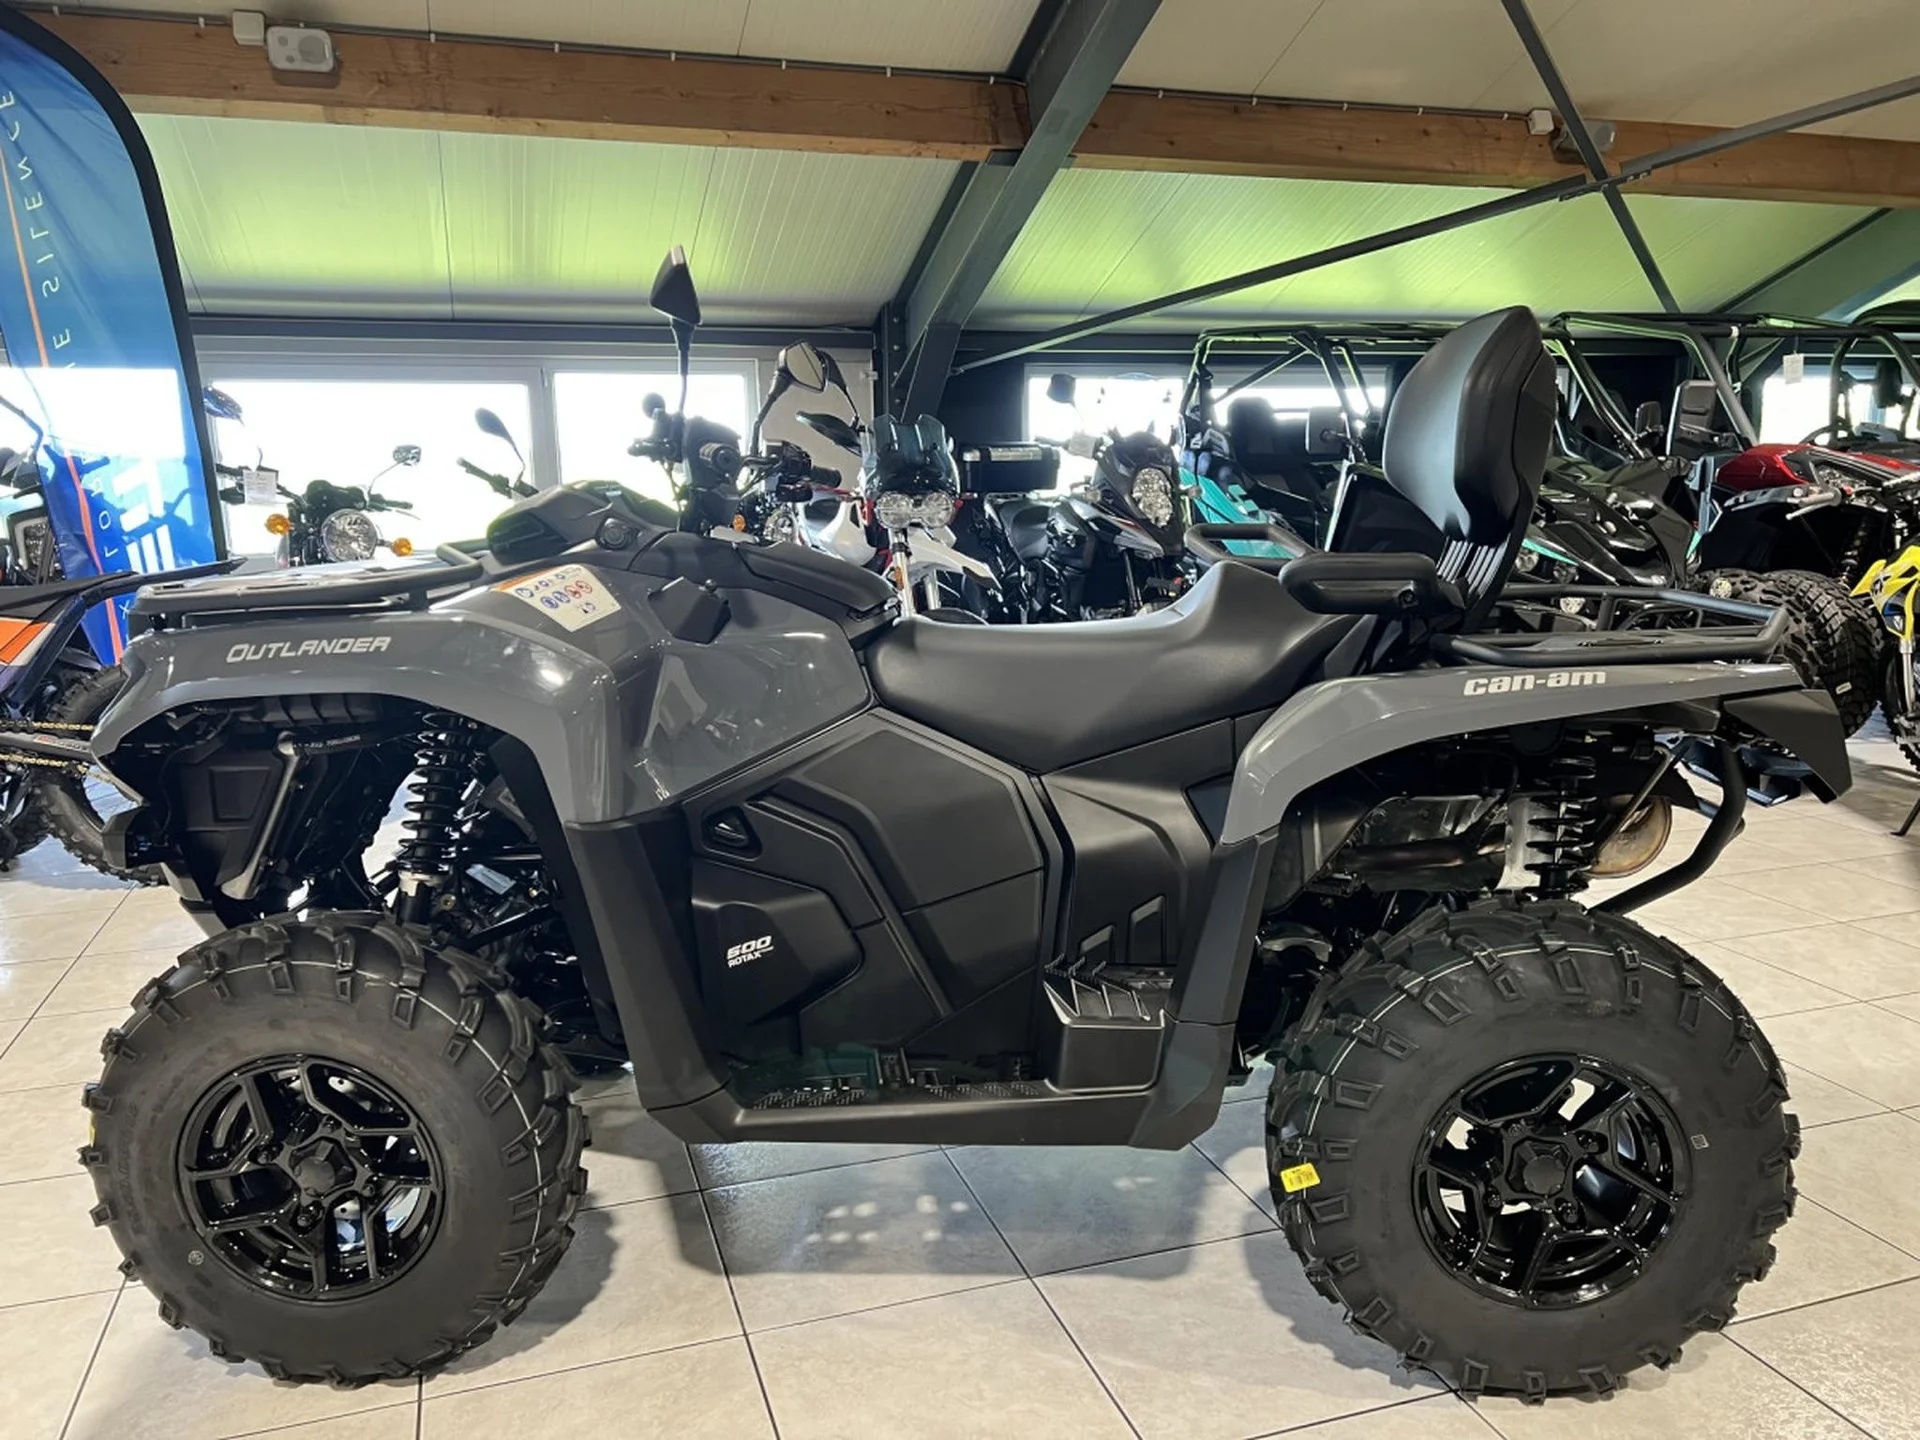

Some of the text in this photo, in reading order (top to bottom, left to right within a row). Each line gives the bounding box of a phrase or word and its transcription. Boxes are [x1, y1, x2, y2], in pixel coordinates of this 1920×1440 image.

[226, 636, 391, 663] OUTLANDER
[1463, 671, 1606, 696] can-am
[727, 949, 764, 968] ROTAX
